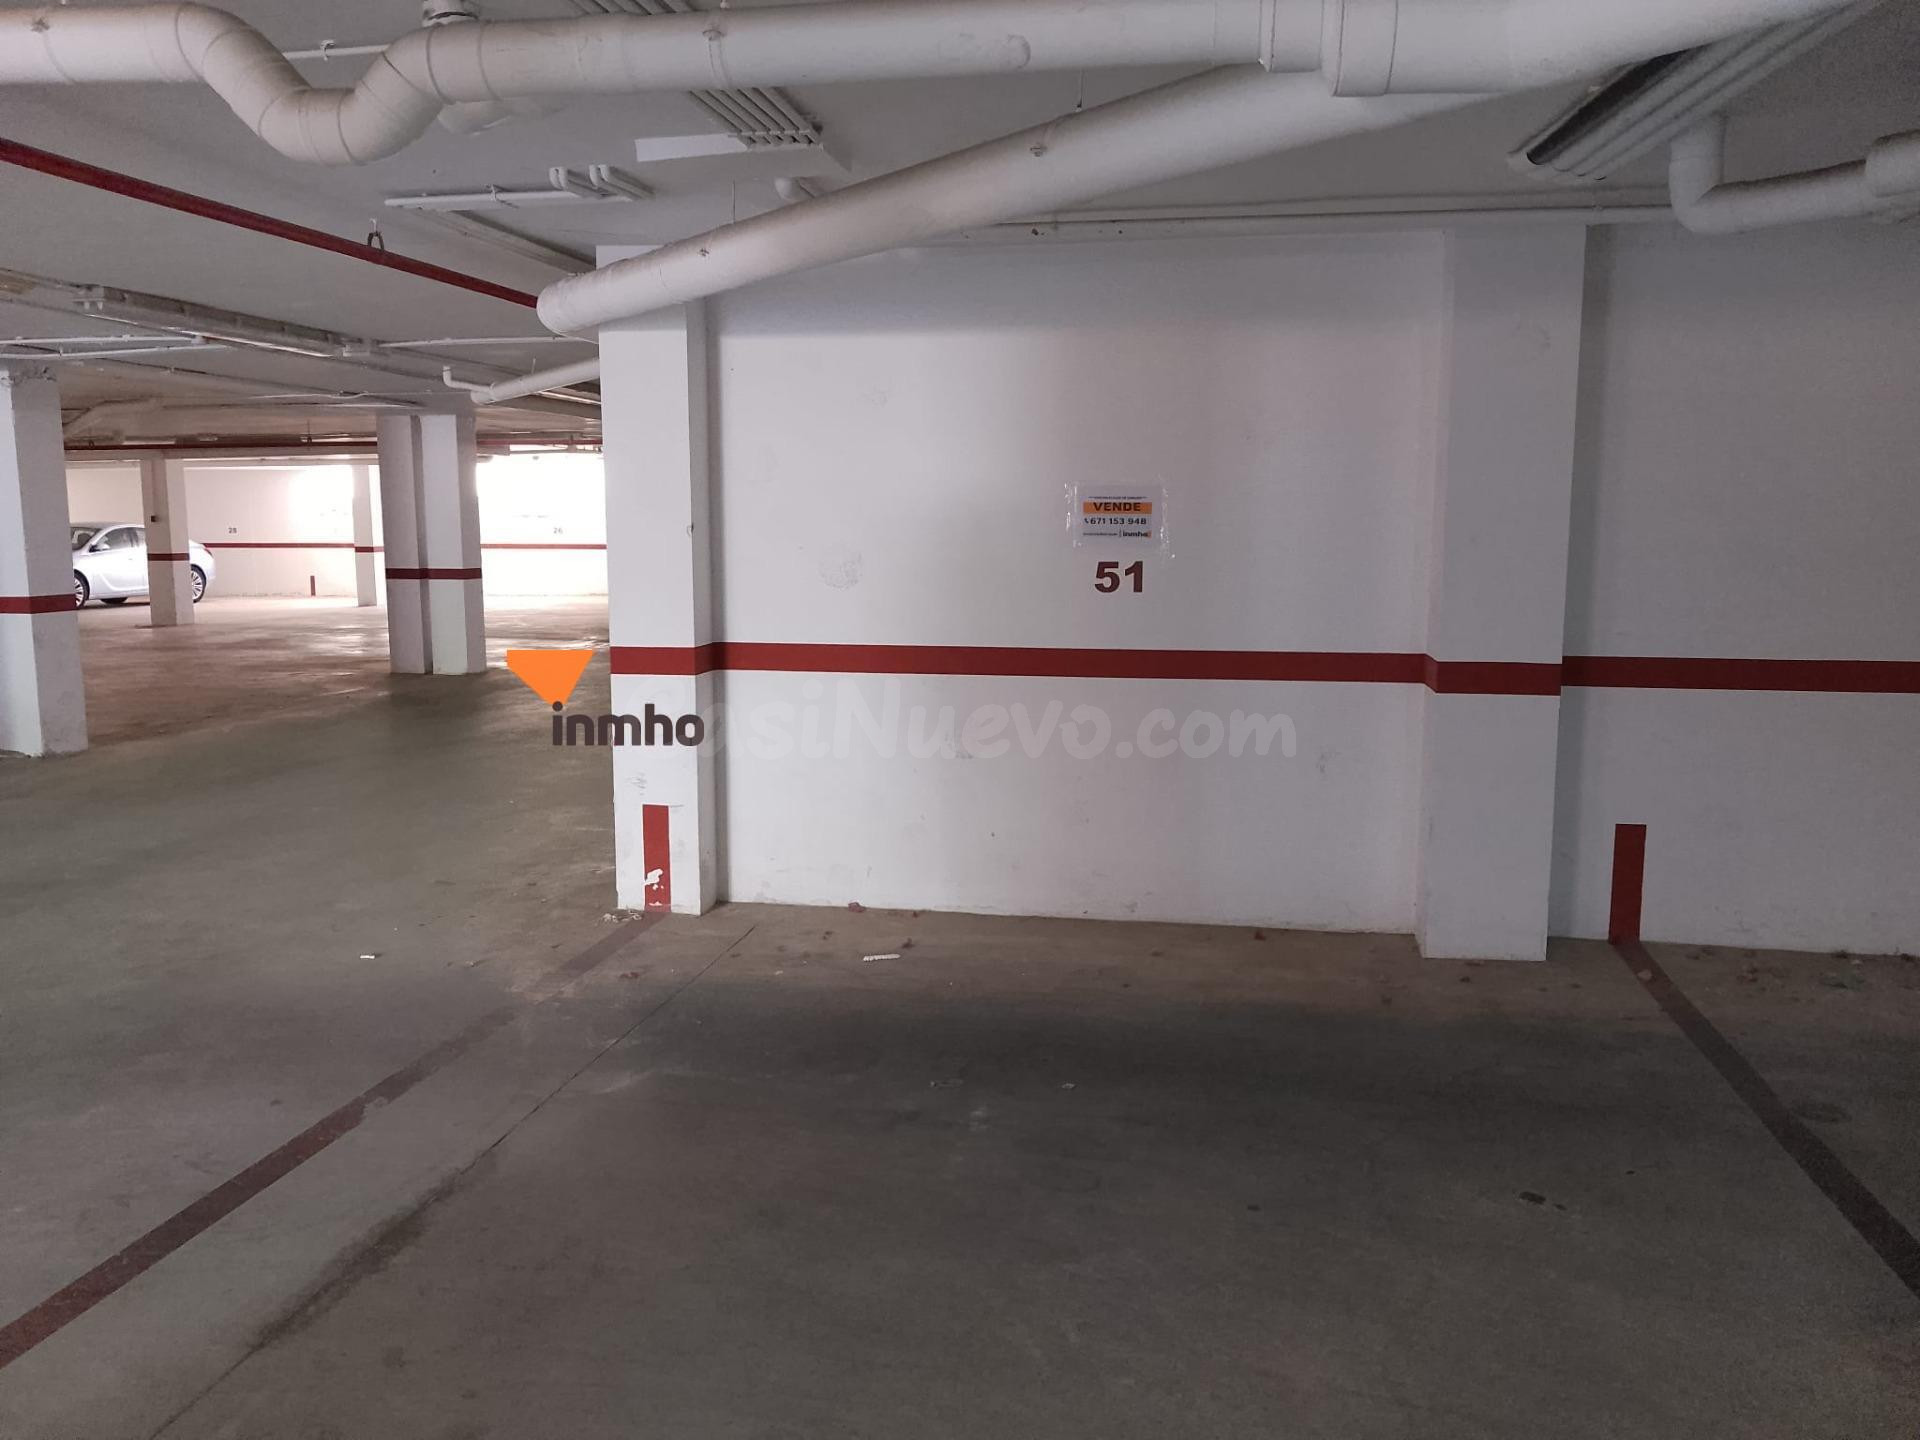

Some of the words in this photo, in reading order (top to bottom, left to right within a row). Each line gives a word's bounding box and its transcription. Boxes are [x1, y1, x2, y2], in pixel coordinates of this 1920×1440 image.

[1093, 502, 1141, 512] VENDE
[1090, 517, 1106, 525] 671
[1110, 517, 1125, 525] 153
[1095, 561, 1144, 593] 51
